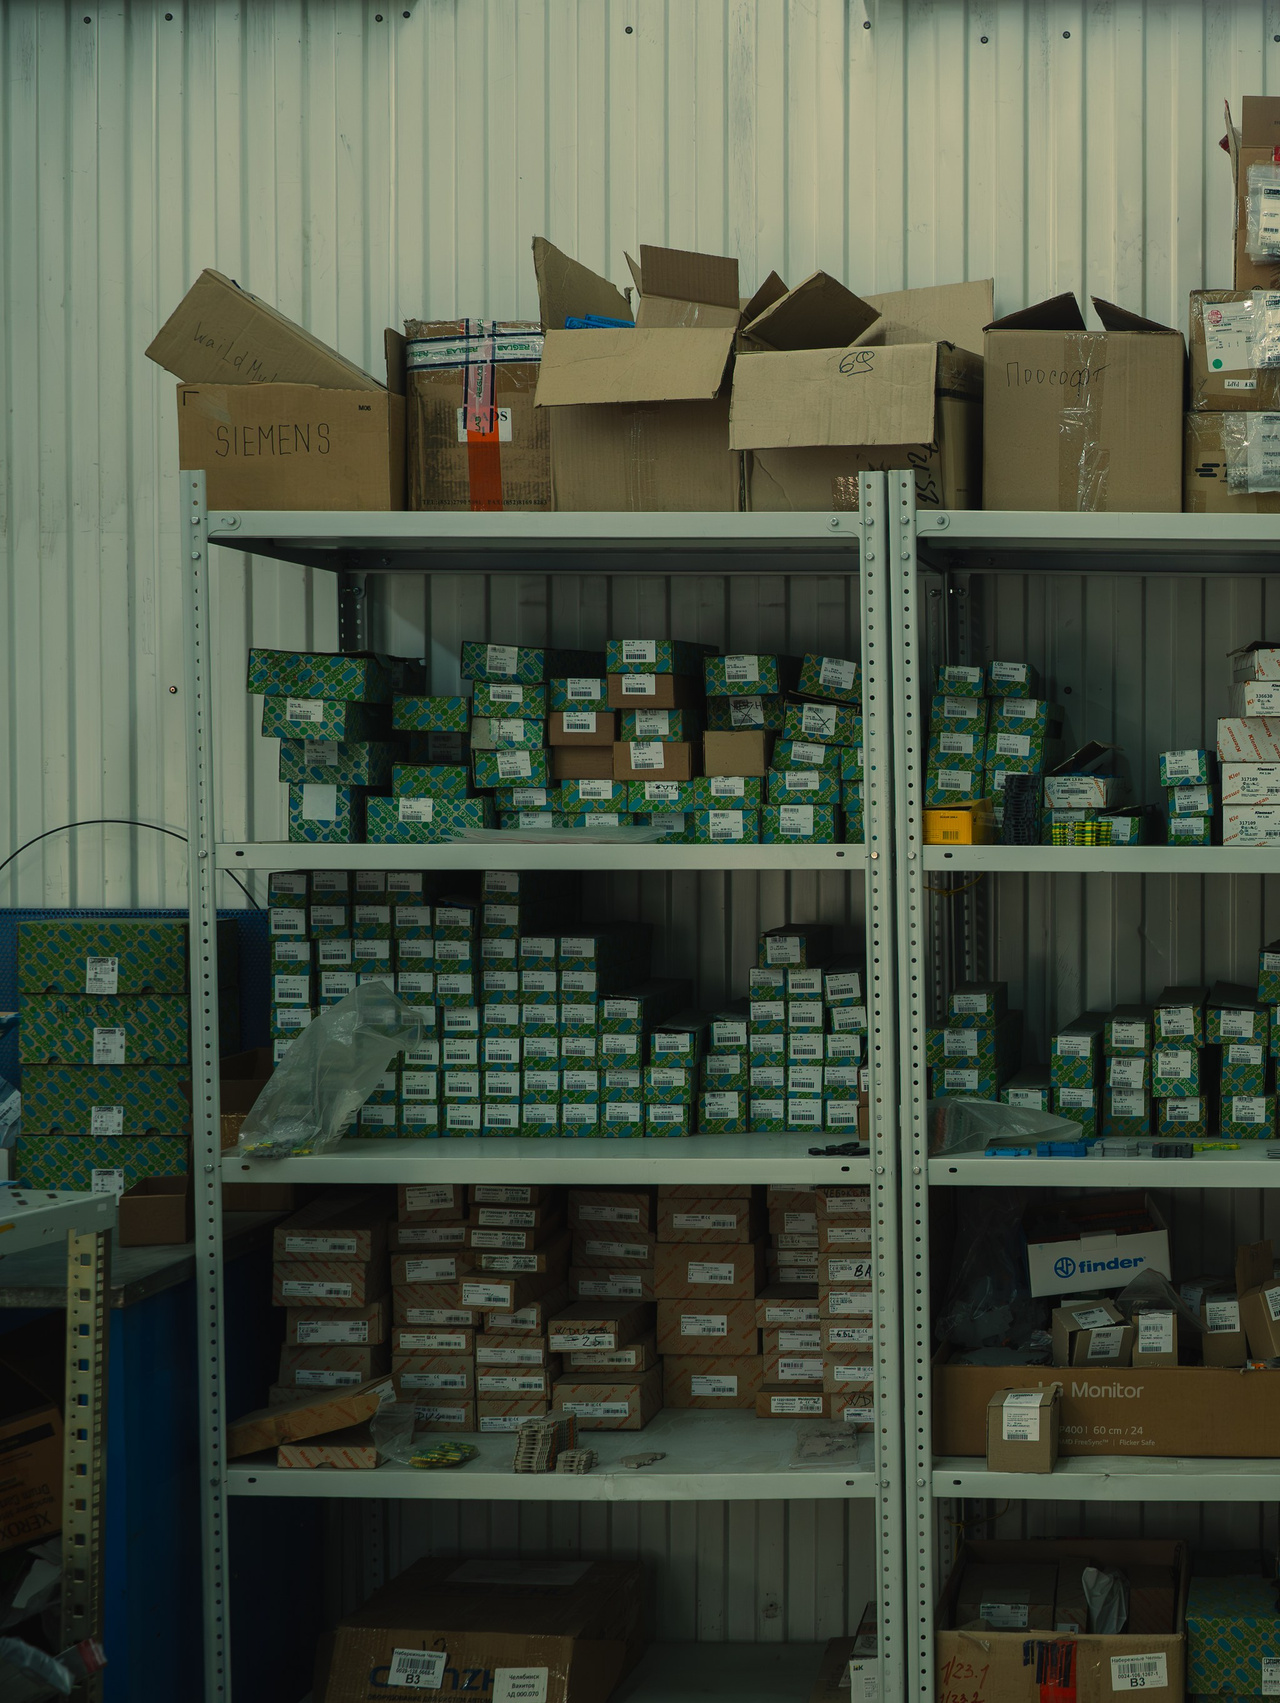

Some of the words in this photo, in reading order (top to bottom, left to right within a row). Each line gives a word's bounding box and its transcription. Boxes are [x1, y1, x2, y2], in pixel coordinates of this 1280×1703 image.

[215, 422, 330, 457] SIEMENS
[1079, 1257, 1144, 1274] finder
[1071, 1382, 1144, 1398] Monitor
[1093, 1426, 1106, 1435] 60
[1131, 1426, 1144, 1435] 24
